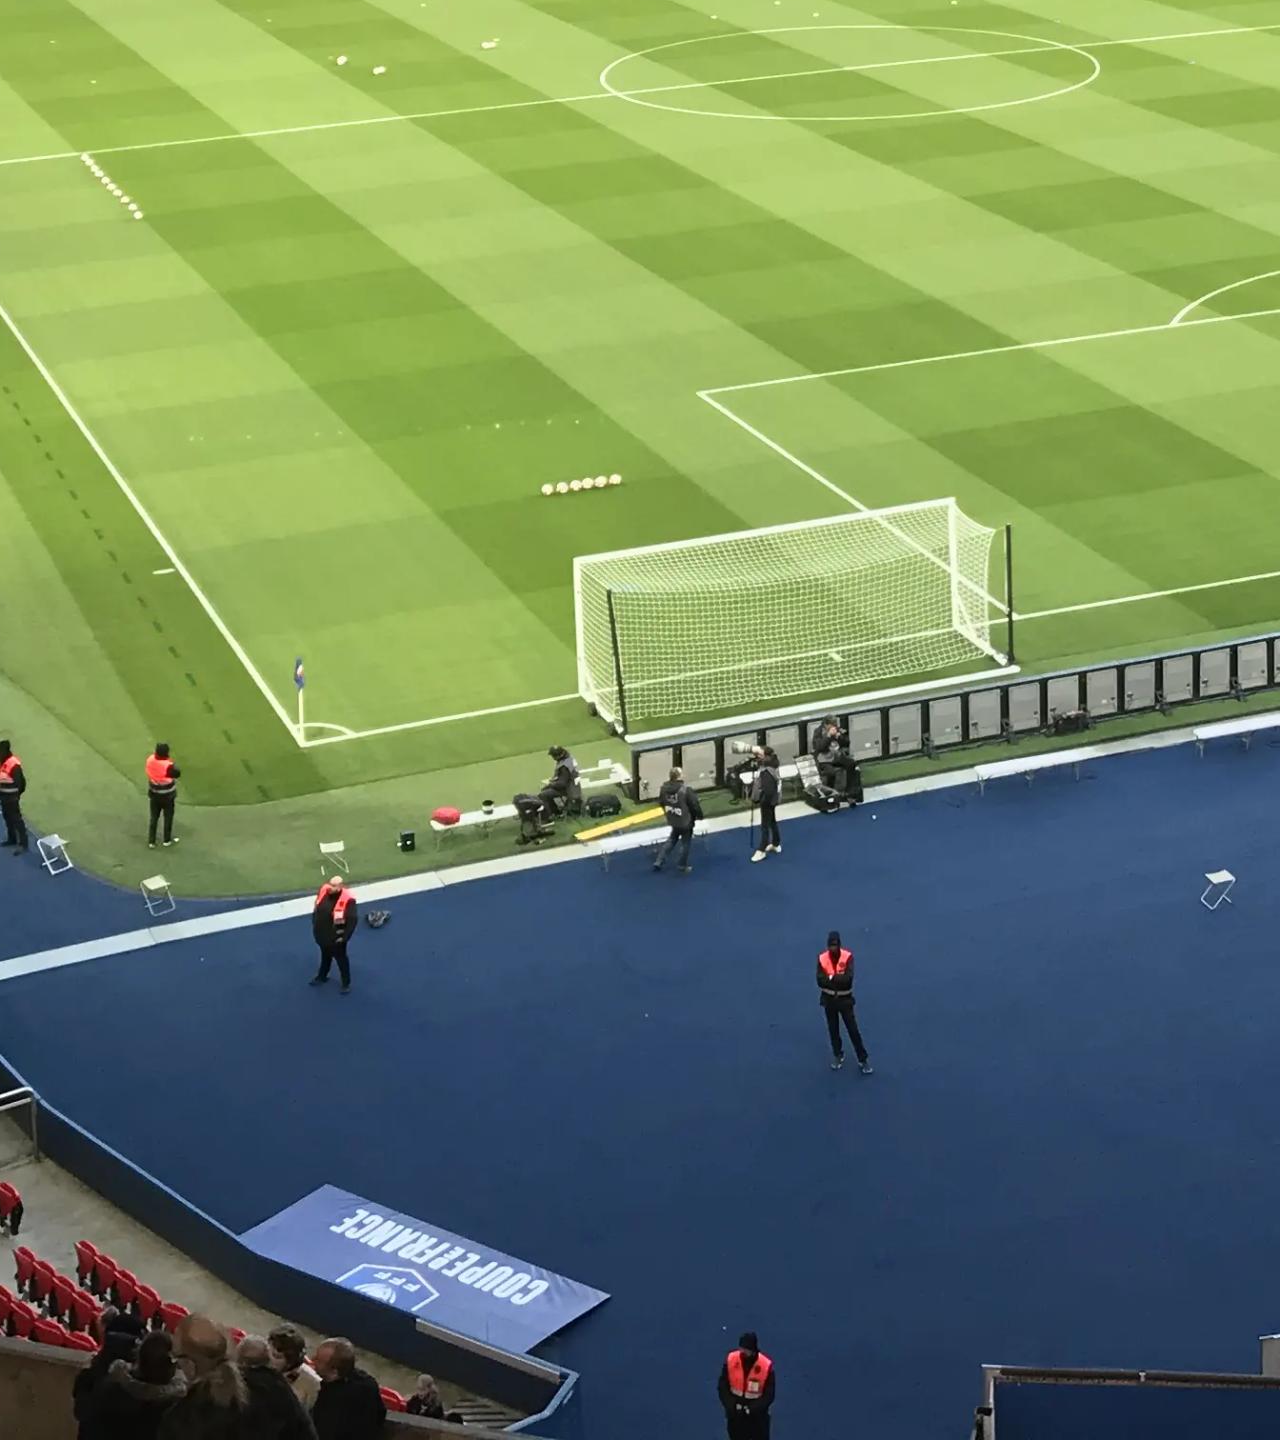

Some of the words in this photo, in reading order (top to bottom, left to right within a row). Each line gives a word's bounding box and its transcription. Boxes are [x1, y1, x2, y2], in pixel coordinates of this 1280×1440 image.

[329, 1208, 452, 1265] FRANCE
[373, 1271, 421, 1293] FFF
[441, 1252, 550, 1306] COUPE
